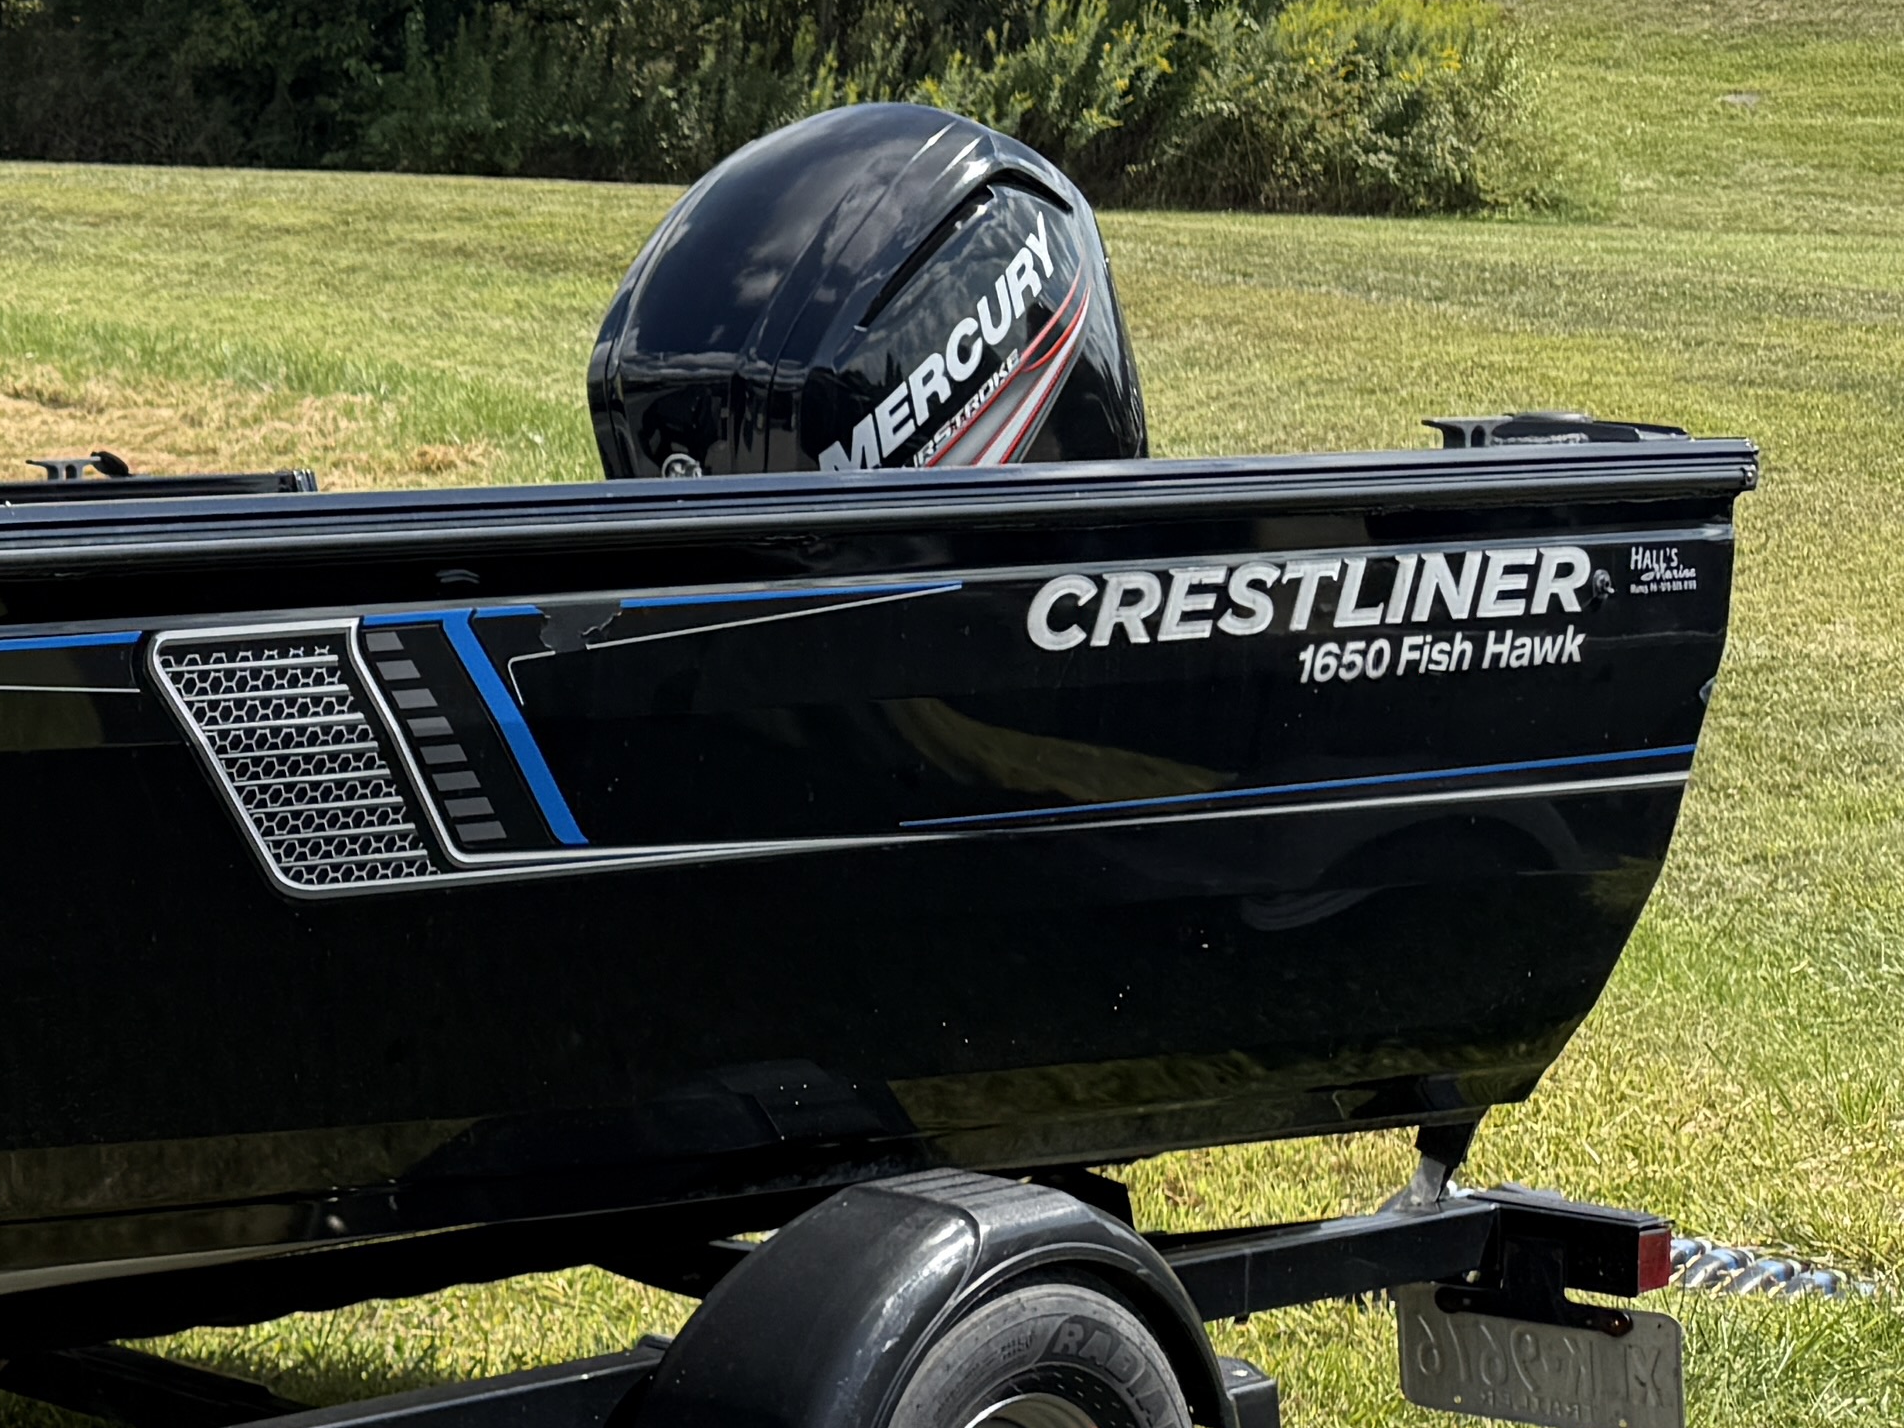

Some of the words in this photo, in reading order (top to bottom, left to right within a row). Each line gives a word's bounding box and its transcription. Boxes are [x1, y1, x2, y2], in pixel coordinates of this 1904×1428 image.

[818, 210, 1054, 472] MERCURY
[1026, 545, 1592, 651] CRESTLINER
[1630, 545, 1679, 571] HALL'S
[1299, 638, 1391, 684] 1650
[1396, 632, 1473, 676] Fish
[1481, 625, 1587, 671] Hawk
